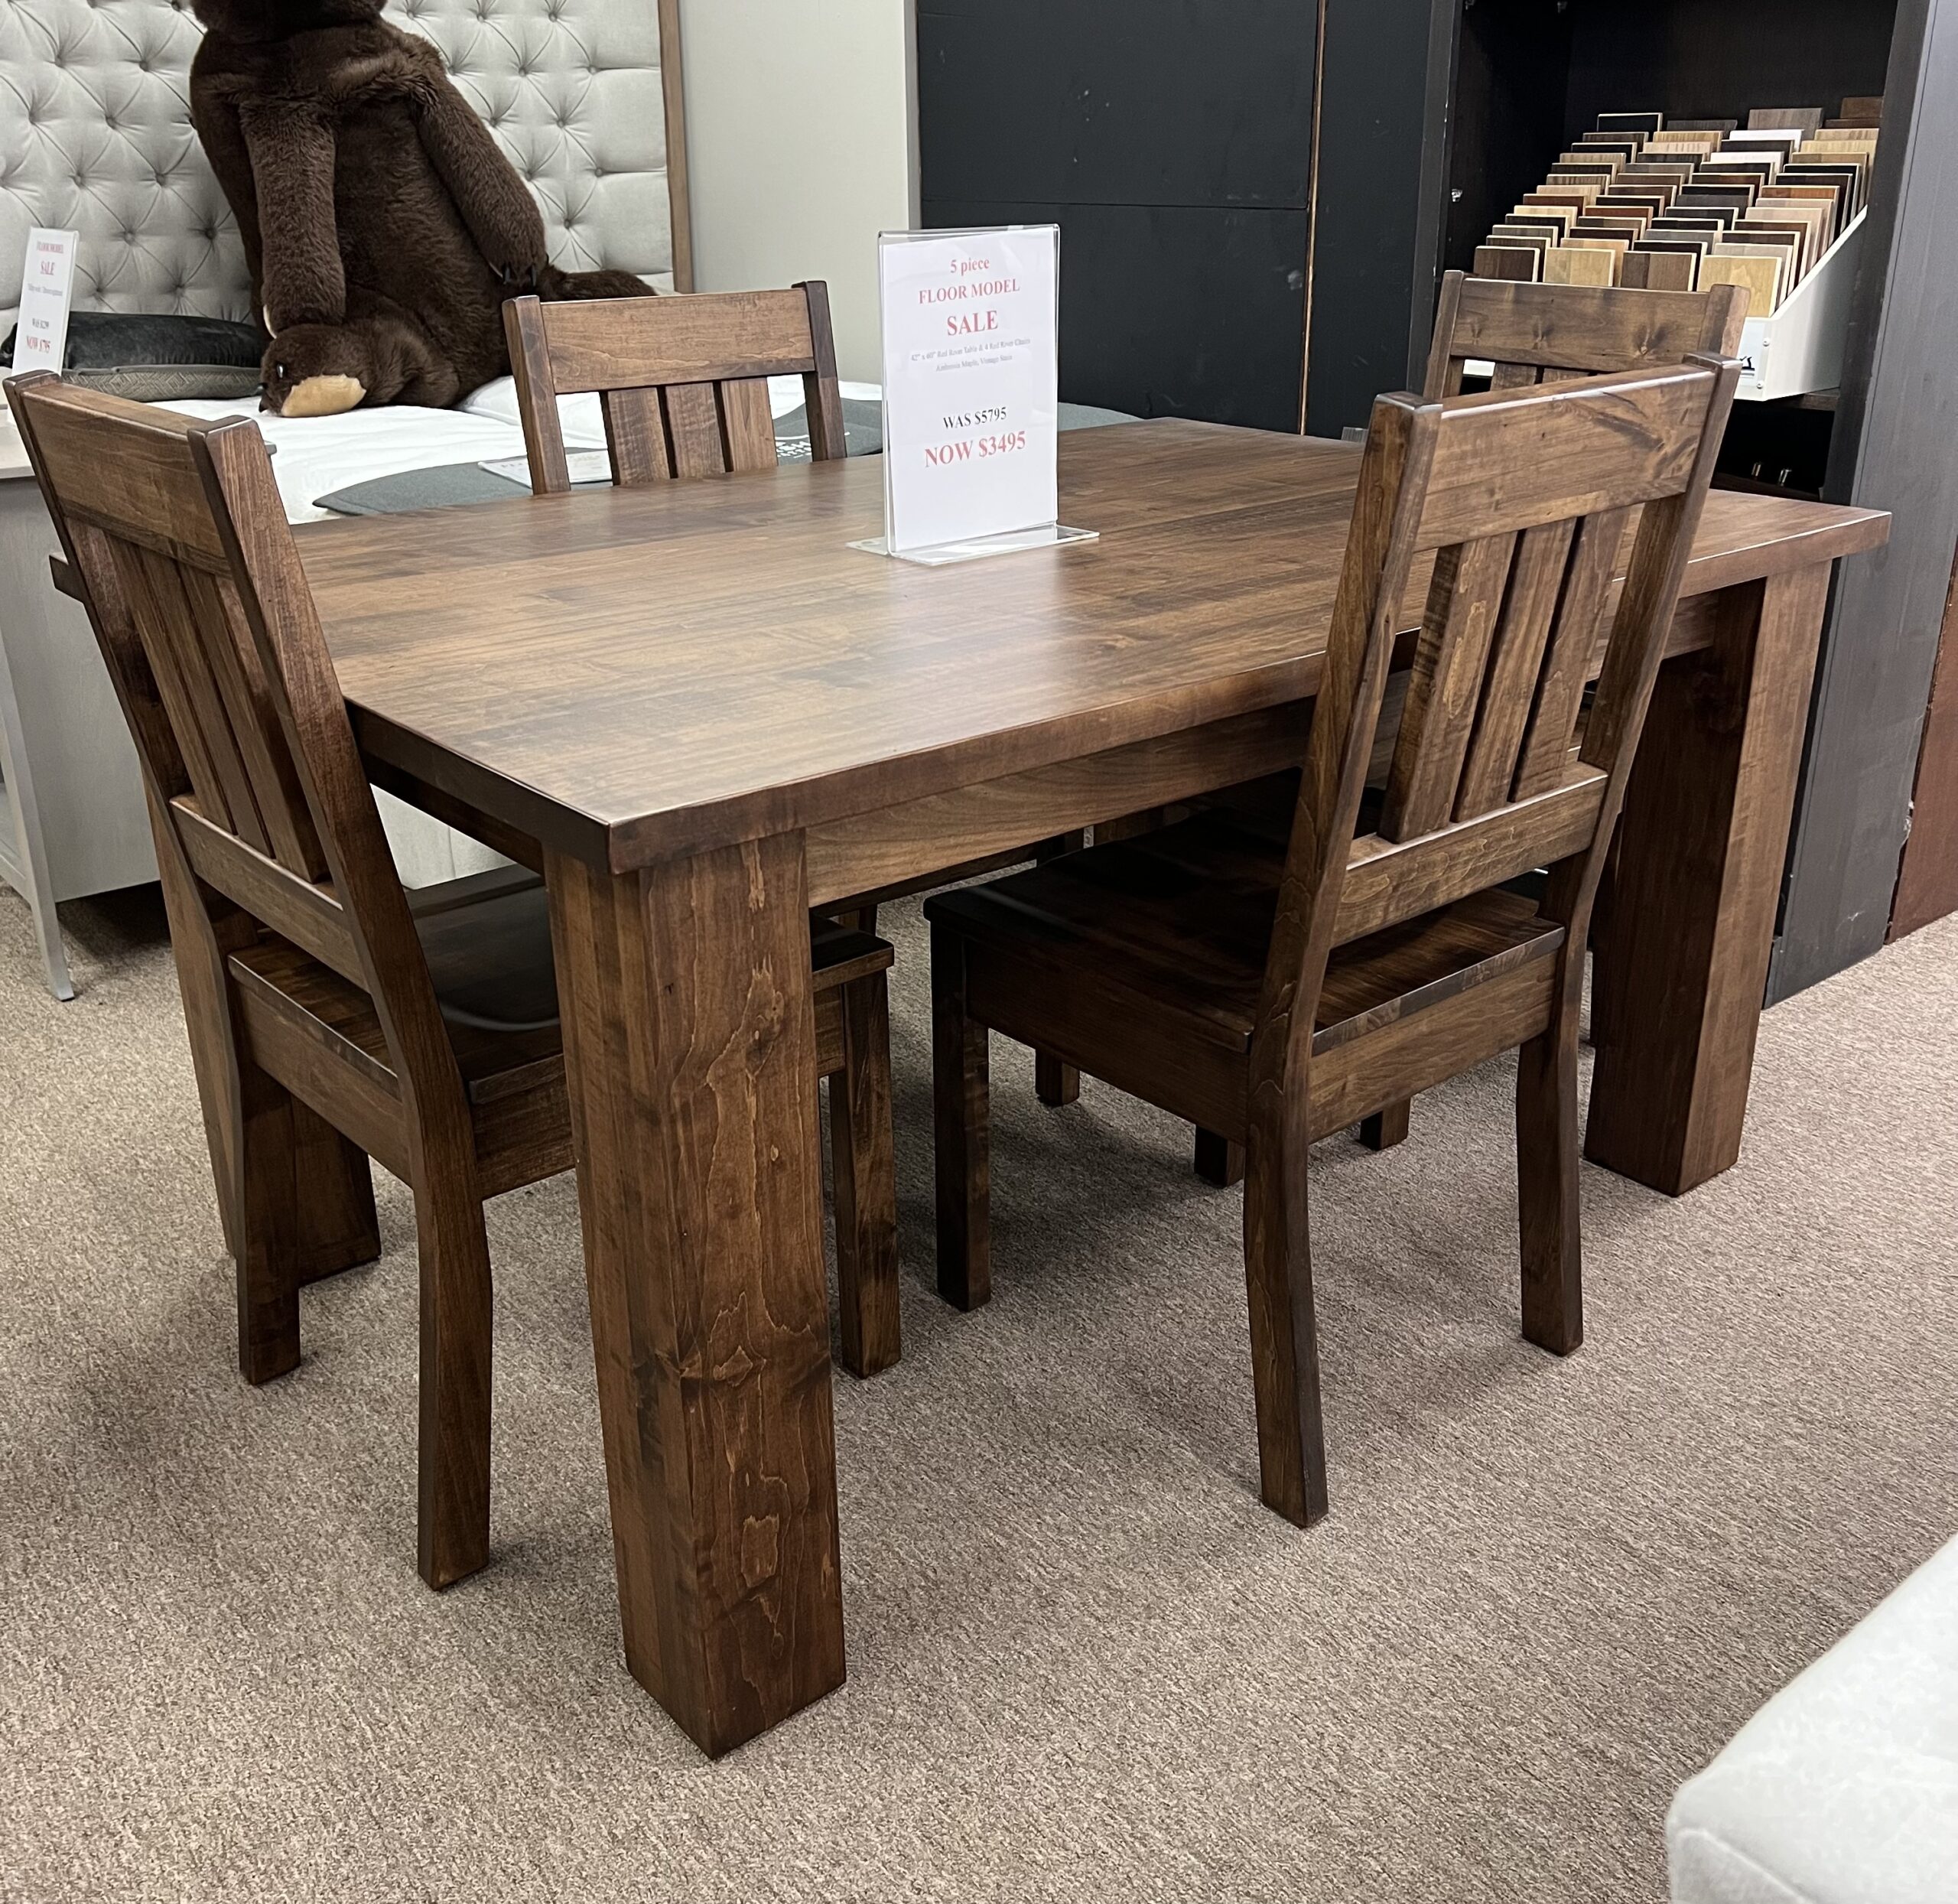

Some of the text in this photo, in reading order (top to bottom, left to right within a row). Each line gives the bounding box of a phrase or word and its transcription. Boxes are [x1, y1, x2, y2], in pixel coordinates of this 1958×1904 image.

[40, 260, 55, 276] SALE
[950, 258, 990, 275] 5 piece
[919, 278, 1020, 304] FLOOR MODEL
[946, 311, 998, 336] SALE
[26, 335, 38, 350] NOW
[943, 406, 1007, 429] WAS $5795
[925, 430, 1026, 468] NOW $3495
